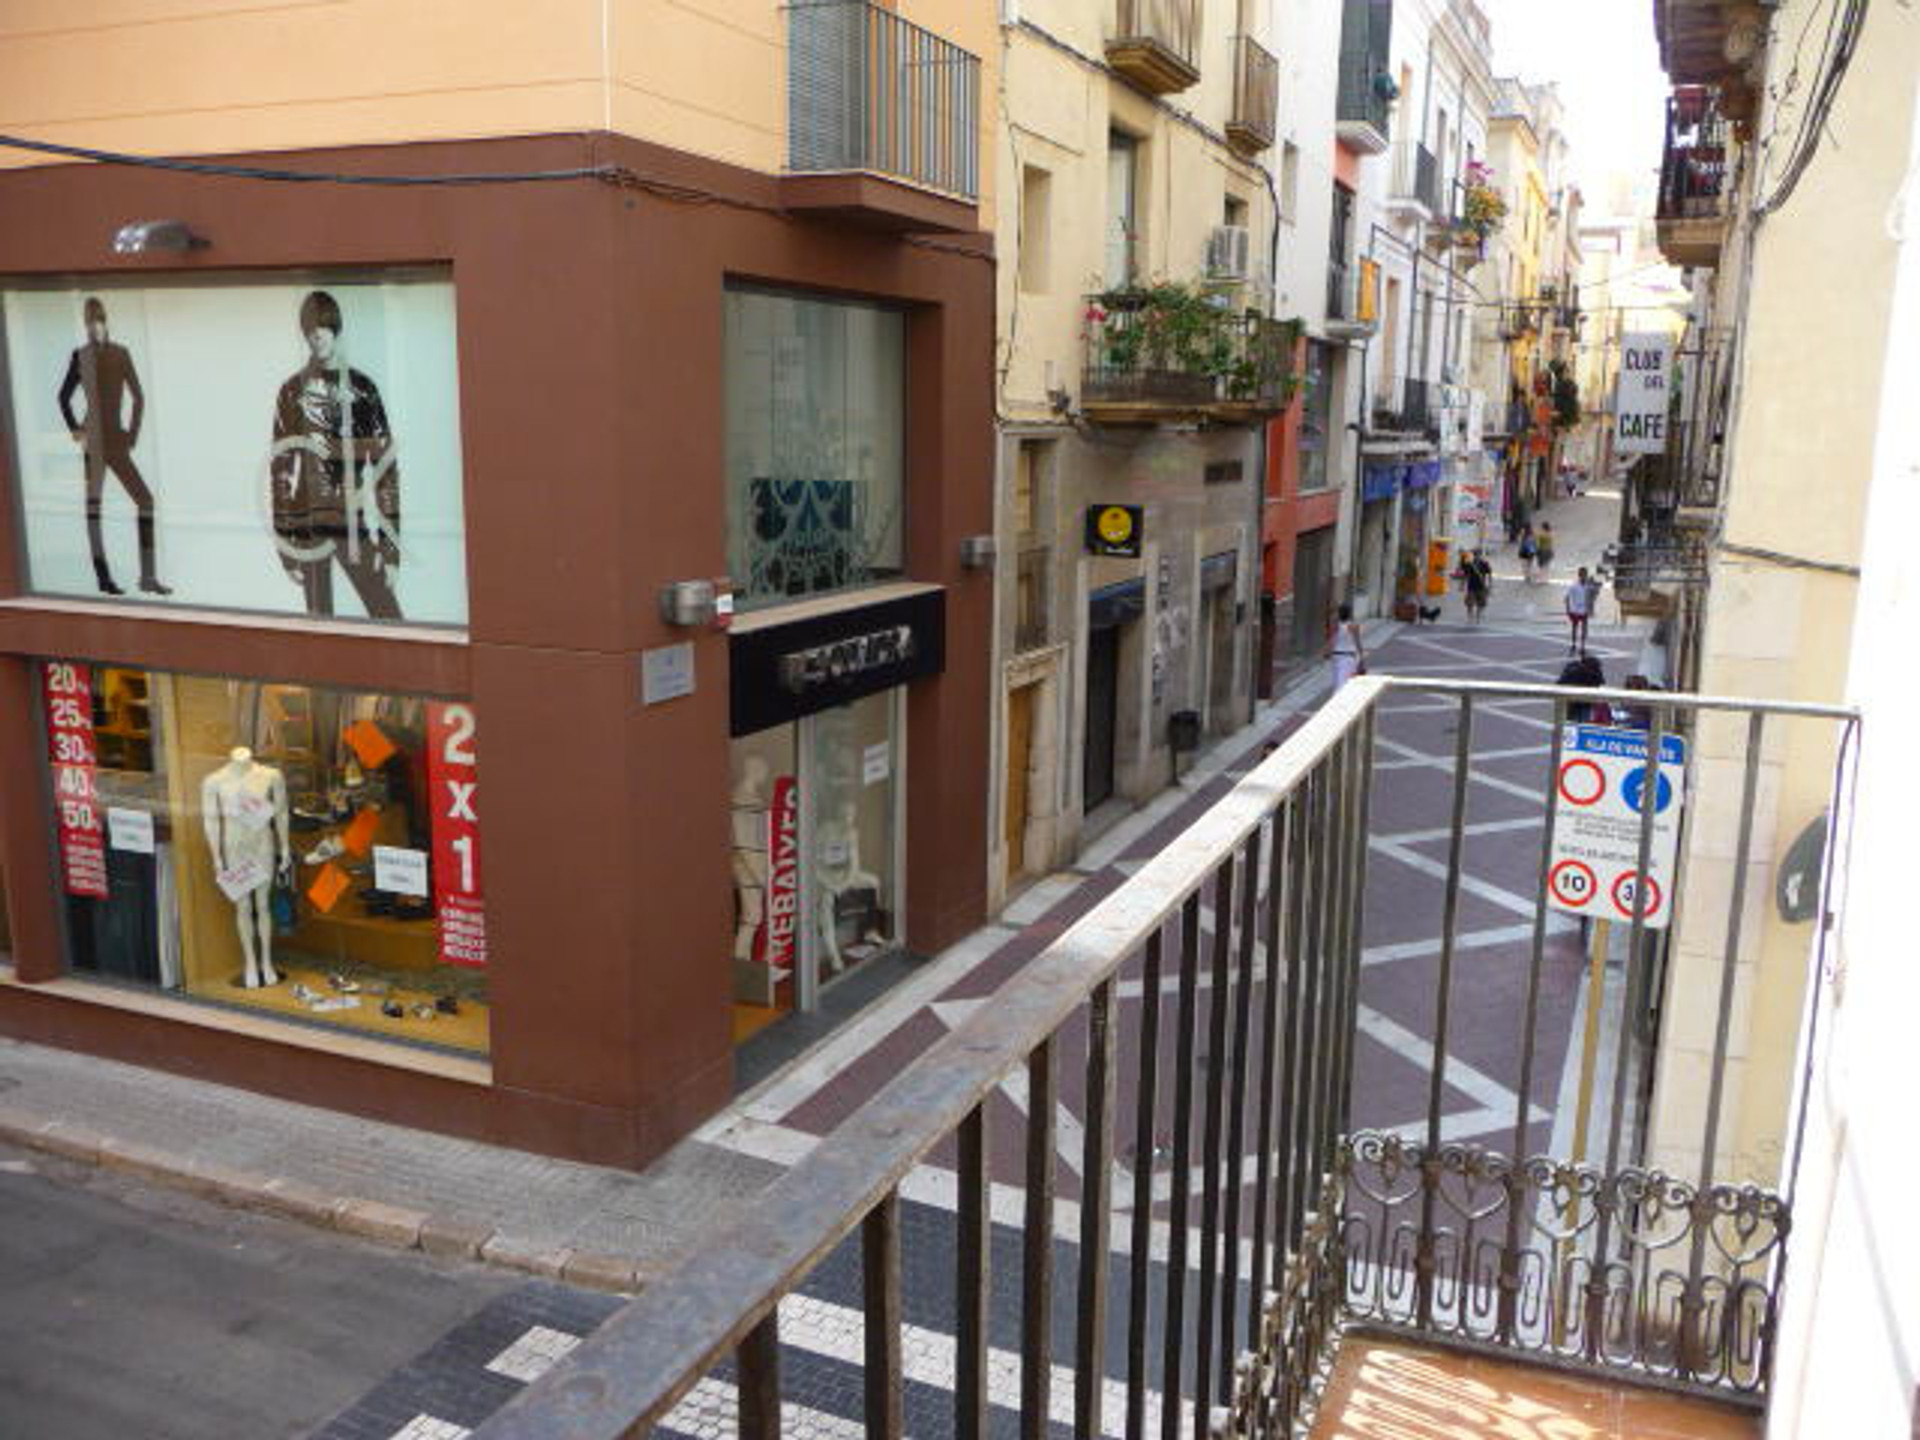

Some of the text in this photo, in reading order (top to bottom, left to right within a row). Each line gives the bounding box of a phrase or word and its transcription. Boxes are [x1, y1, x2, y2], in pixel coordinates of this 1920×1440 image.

[1626, 348, 1663, 370] CLUB
[443, 705, 476, 765] 2
[453, 836, 473, 892] 1
[1563, 874, 1586, 892] 10
